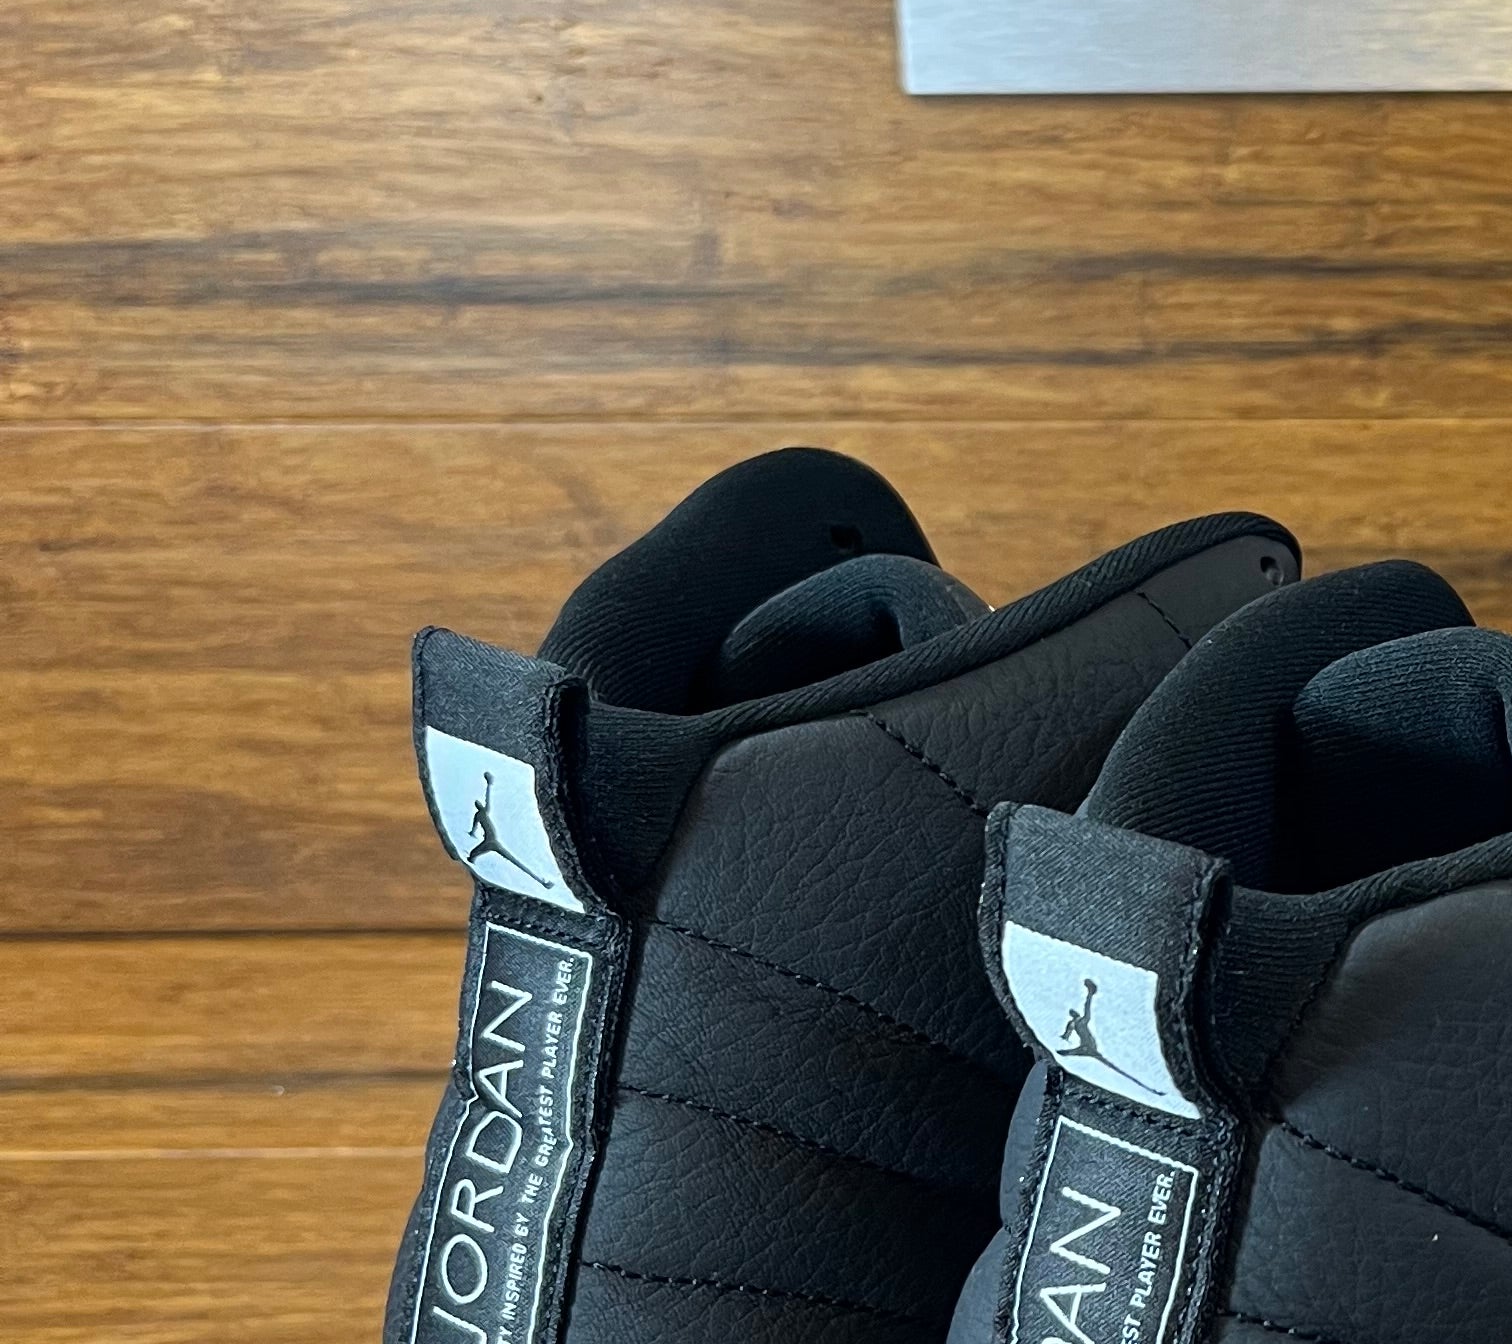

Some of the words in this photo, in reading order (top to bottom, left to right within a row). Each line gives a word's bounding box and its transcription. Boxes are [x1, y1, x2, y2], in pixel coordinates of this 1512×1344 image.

[552, 957, 575, 1005] EVER.
[541, 1011, 563, 1079] PLAYER
[535, 1085, 557, 1167] GREATEST
[521, 1173, 544, 1204] THE
[514, 1212, 530, 1237] BY
[1129, 1231, 1162, 1308] PLAYER
[1147, 1170, 1176, 1225] EVER.
[502, 1242, 528, 1321] INSPIRED
